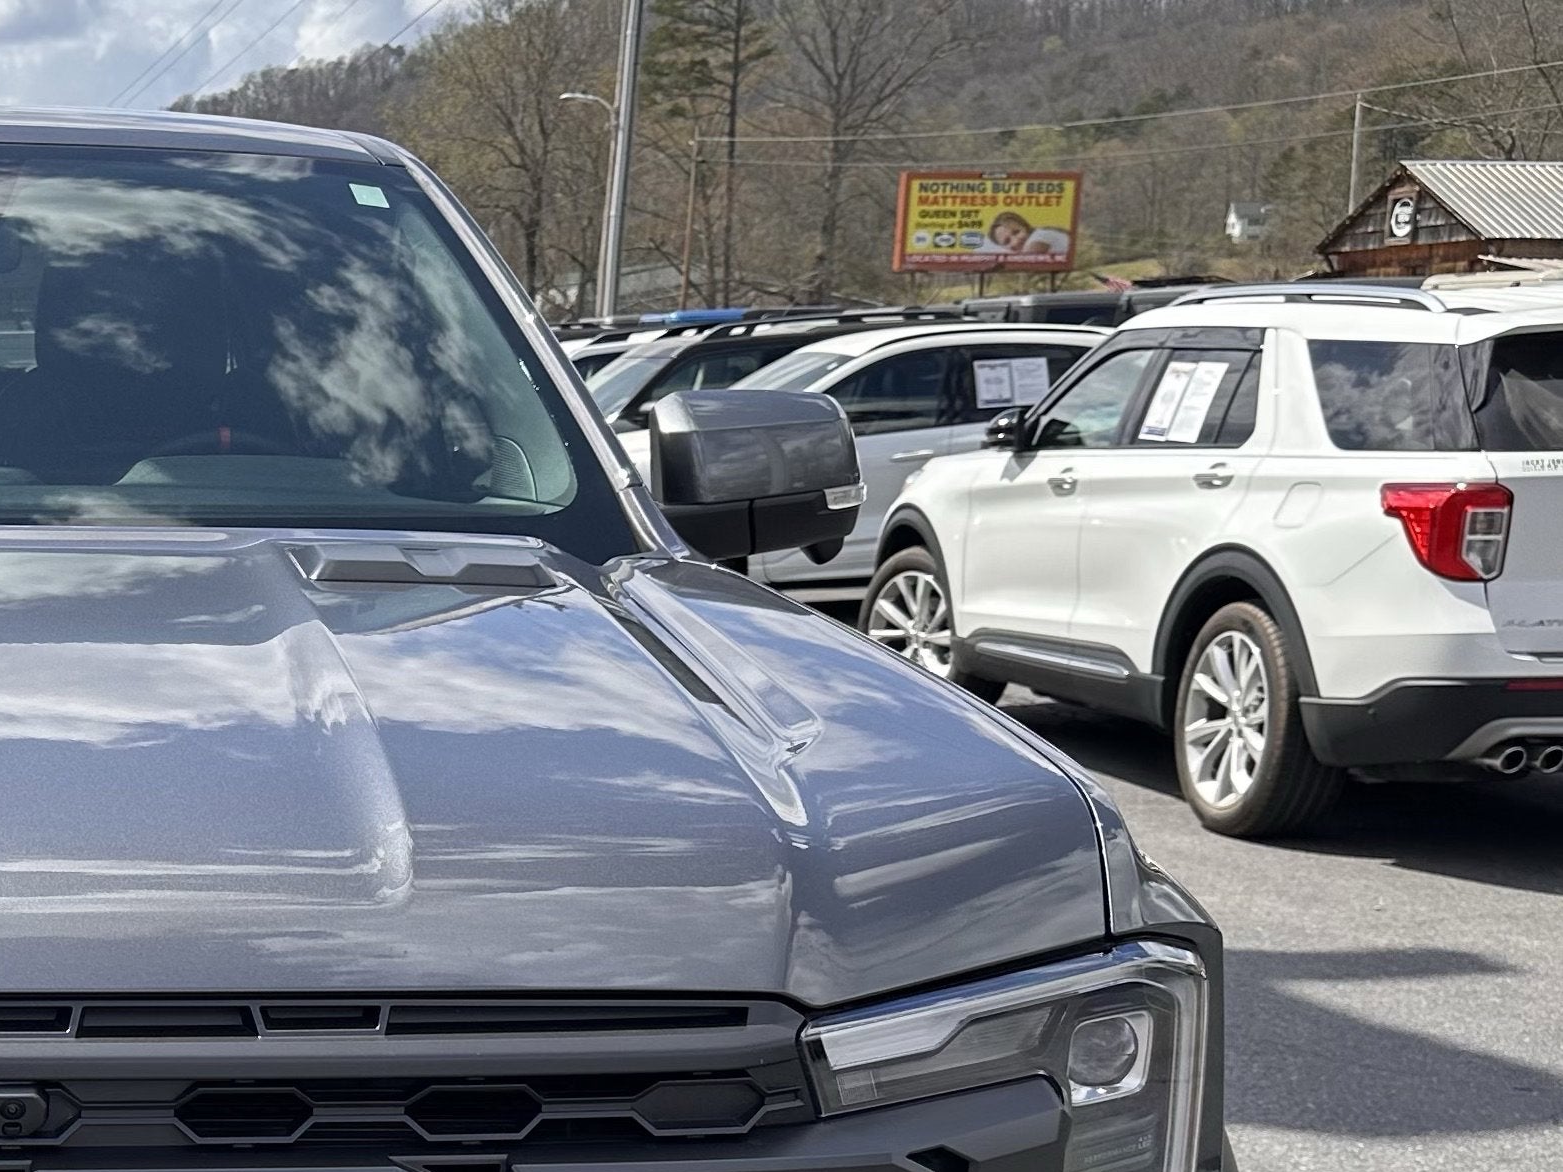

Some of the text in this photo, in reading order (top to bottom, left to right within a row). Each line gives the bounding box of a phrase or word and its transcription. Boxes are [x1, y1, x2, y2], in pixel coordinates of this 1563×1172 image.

[918, 182, 1065, 194] NOTHING BUT BEDS
[917, 195, 1062, 207] MATTRESS OUTLET
[918, 209, 981, 219] QUEEN SET
